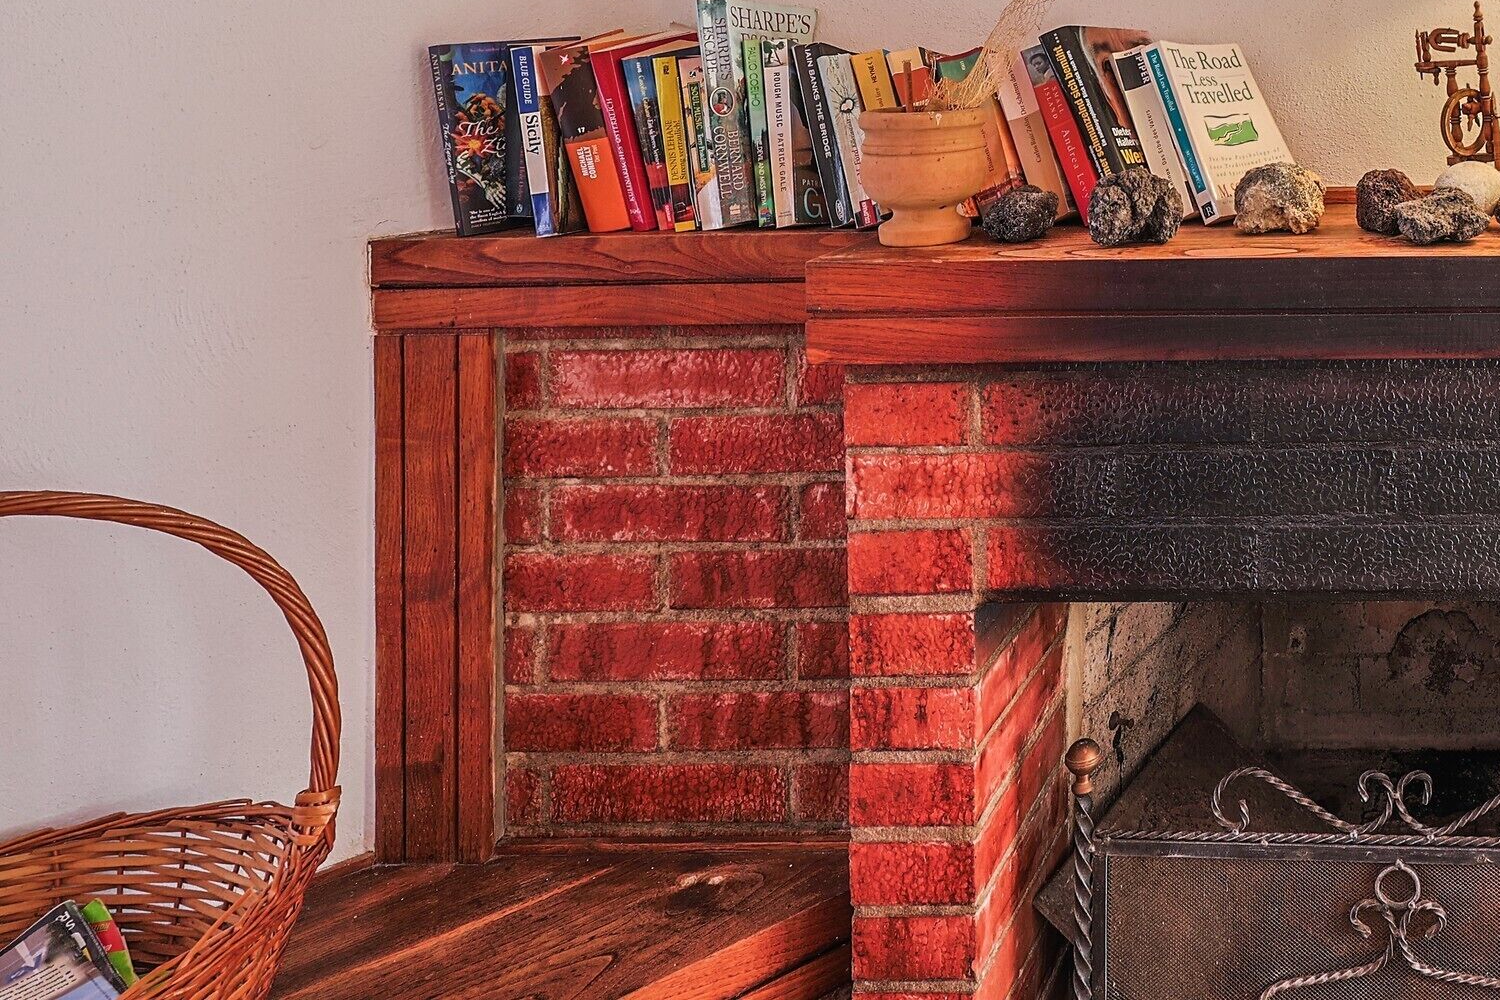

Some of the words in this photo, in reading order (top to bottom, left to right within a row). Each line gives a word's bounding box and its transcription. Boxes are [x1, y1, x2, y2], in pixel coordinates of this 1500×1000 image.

[730, 5, 812, 35] SHARPE'S
[519, 56, 528, 76] BLUE
[703, 27, 717, 75] ESCAPE
[748, 47, 757, 71] PAULO
[805, 49, 814, 67] IAIN
[1053, 45, 1074, 81] bemüht
[1167, 48, 1197, 70] The
[1197, 49, 1242, 70] Road
[431, 54, 441, 80] ANITA
[436, 84, 445, 111] DESAI
[451, 61, 508, 76] ANITA
[1138, 56, 1150, 84] PIPER
[1190, 71, 1218, 87] Less
[522, 77, 532, 105] GUIDE
[691, 85, 699, 106] SOUL
[749, 73, 760, 107] COELHO
[809, 70, 820, 101] BANKS
[1052, 86, 1064, 115] SMALL
[1068, 79, 1081, 98] sich
[1182, 81, 1254, 104] Travelled
[694, 107, 703, 130] MUSIC
[816, 102, 825, 122] THE
[1043, 88, 1058, 120] ISLAND
[459, 119, 499, 138] The
[526, 115, 542, 155] Sicily
[774, 72, 782, 99] ROUGH
[778, 133, 786, 168] PATRICK
[1075, 97, 1104, 158] schmunzelnd
[665, 121, 676, 152] LEHANE
[820, 124, 832, 159] BRIDGE
[577, 147, 590, 177] MICHAEL
[583, 146, 598, 179] CONNELLY
[669, 153, 679, 181] DENNIS
[714, 126, 732, 199] CORNWELL
[728, 130, 745, 191] BERNARD
[1062, 129, 1079, 170] Andrea
[1077, 173, 1090, 199] Levy
